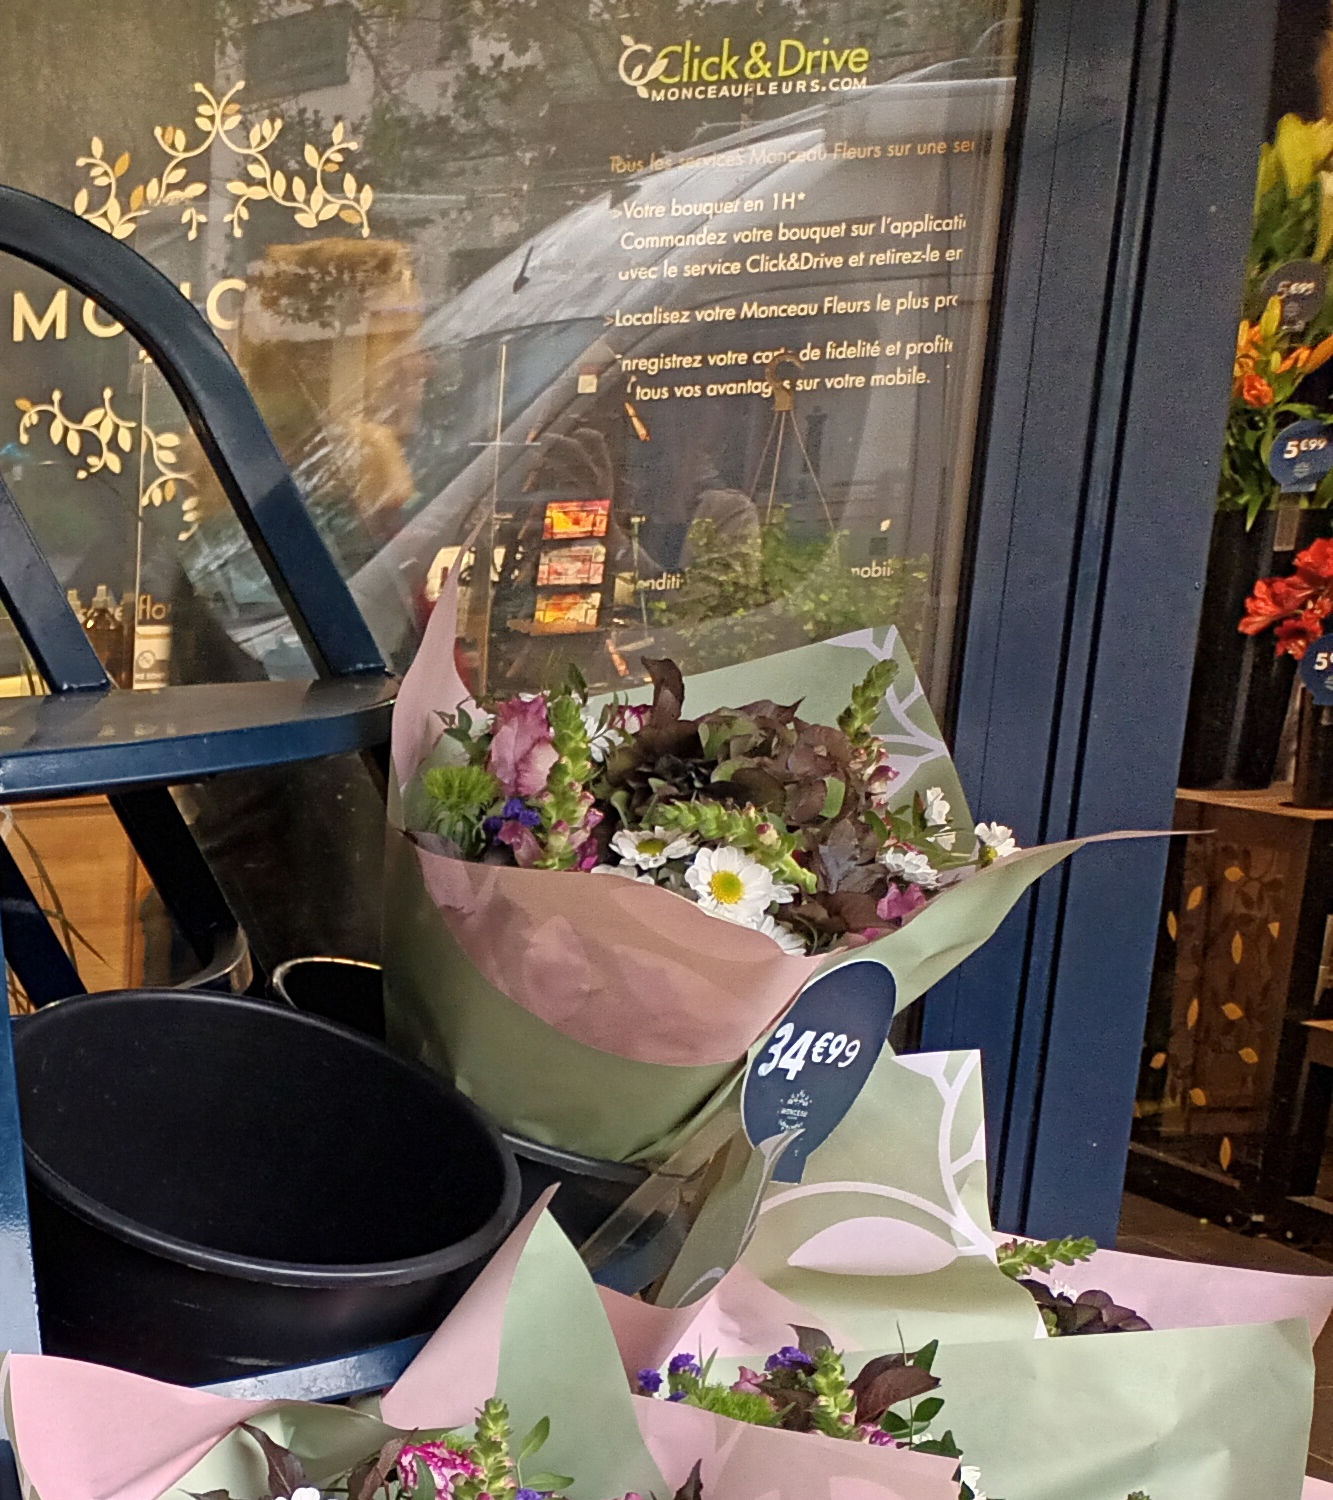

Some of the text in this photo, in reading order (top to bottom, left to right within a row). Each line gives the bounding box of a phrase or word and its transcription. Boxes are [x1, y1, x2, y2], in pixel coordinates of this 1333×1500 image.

[743, 40, 772, 80] &
[777, 37, 870, 78] Drive
[650, 76, 868, 102] MONCEAUFLEURS.COM
[609, 154, 645, 174] Tous
[649, 152, 673, 171] les
[678, 151, 745, 169] services
[748, 147, 827, 166] Monceau
[833, 141, 882, 160] Fleurs
[886, 143, 912, 157] sur
[917, 140, 948, 155] une
[670, 197, 740, 220] bouquet
[743, 199, 764, 213] en
[620, 213, 966, 251] Commandez votre bouquet sur l'applicati
[618, 266, 658, 281] avec
[662, 260, 678, 279] le
[683, 258, 742, 277] service
[745, 251, 844, 274] Click&Drive
[848, 251, 865, 268] et
[869, 243, 940, 266] retirez-le
[694, 306, 736, 323] votre
[740, 301, 819, 320] Monceau
[823, 295, 872, 315] Fleurs
[876, 293, 891, 312] le
[895, 290, 930, 316] plus
[615, 352, 703, 376] nregistrez
[707, 350, 749, 367] votre
[798, 341, 821, 362] de
[825, 339, 882, 360] fidelité
[885, 341, 902, 357] et
[635, 365, 932, 401] tous vos avantags sur votre mobile.
[757, 1022, 861, 1081] 34€99
